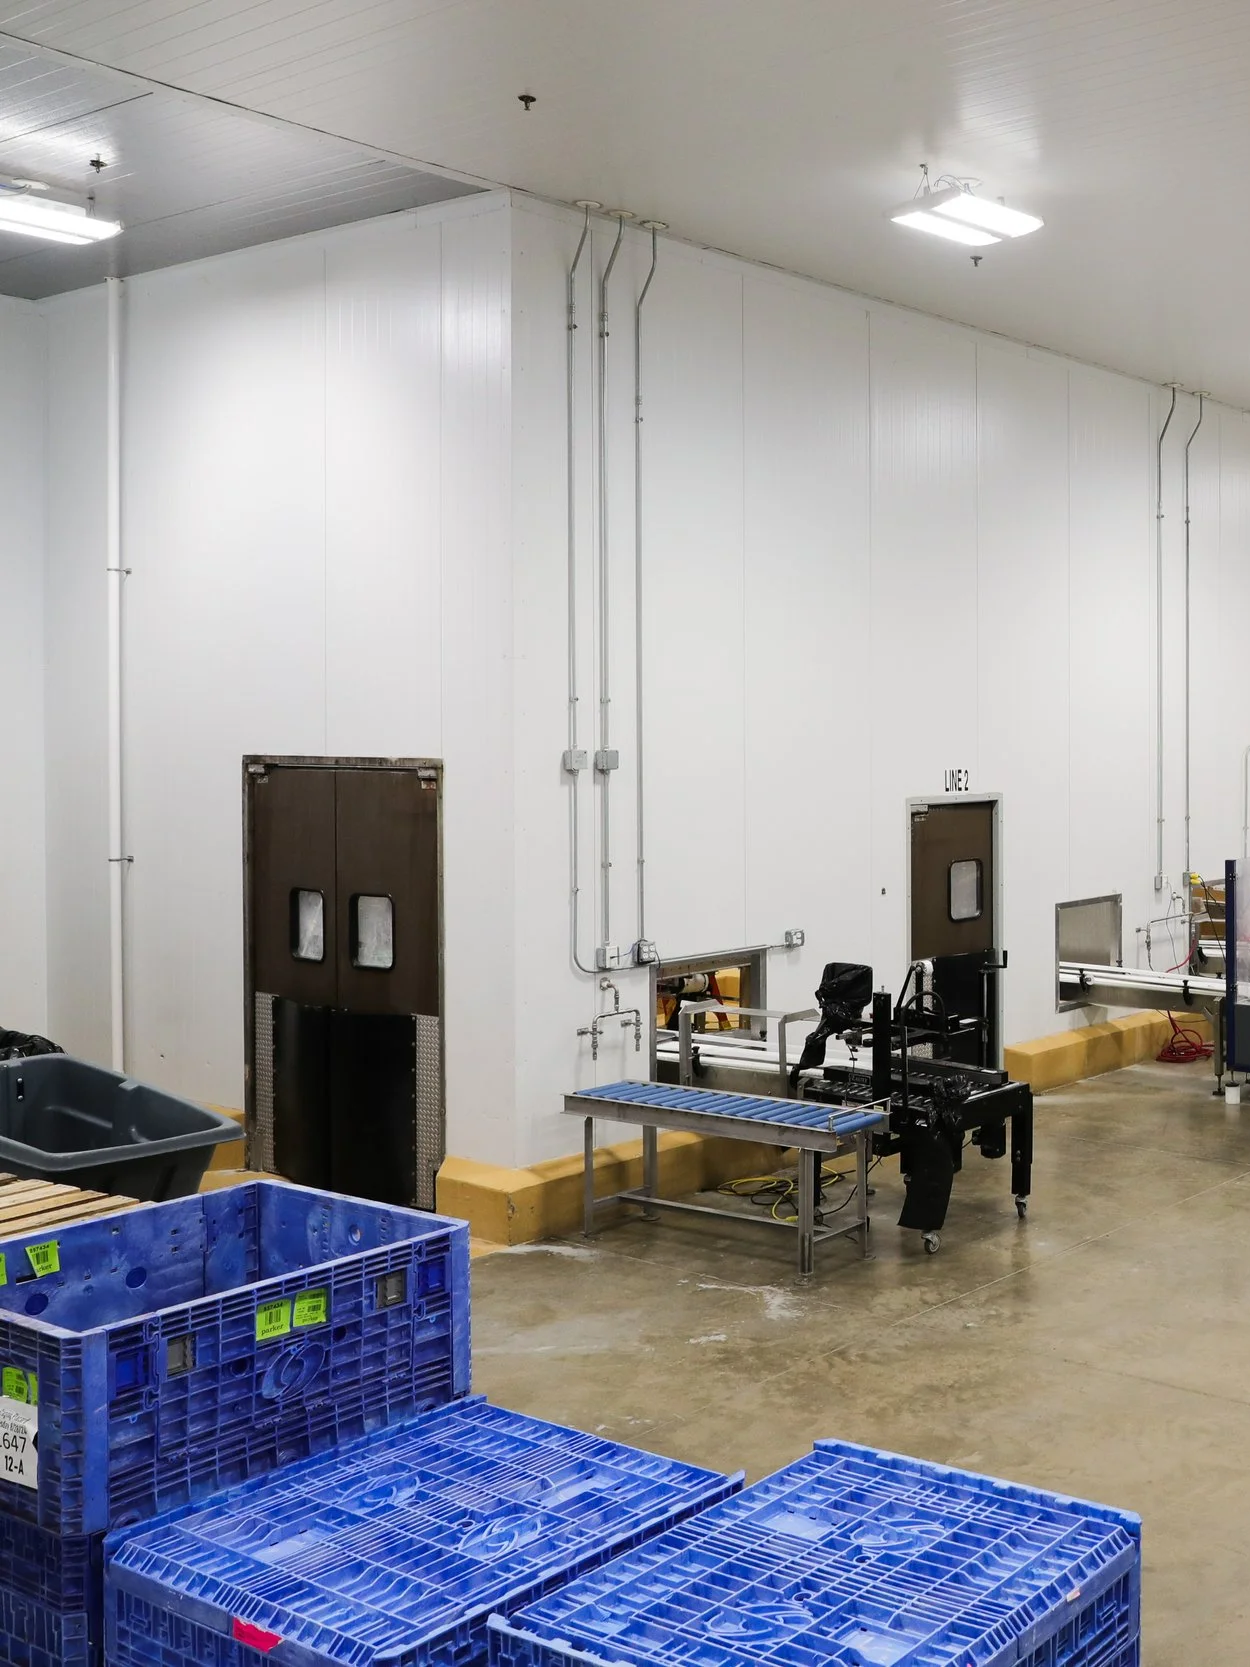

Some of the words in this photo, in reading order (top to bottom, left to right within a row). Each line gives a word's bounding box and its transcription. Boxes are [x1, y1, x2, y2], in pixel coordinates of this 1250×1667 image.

[945, 769, 962, 792] LINE
[964, 769, 969, 791] 2
[261, 1324, 284, 1336] parker
[0, 1432, 26, 1453] 647
[5, 1455, 24, 1475] 12-A
